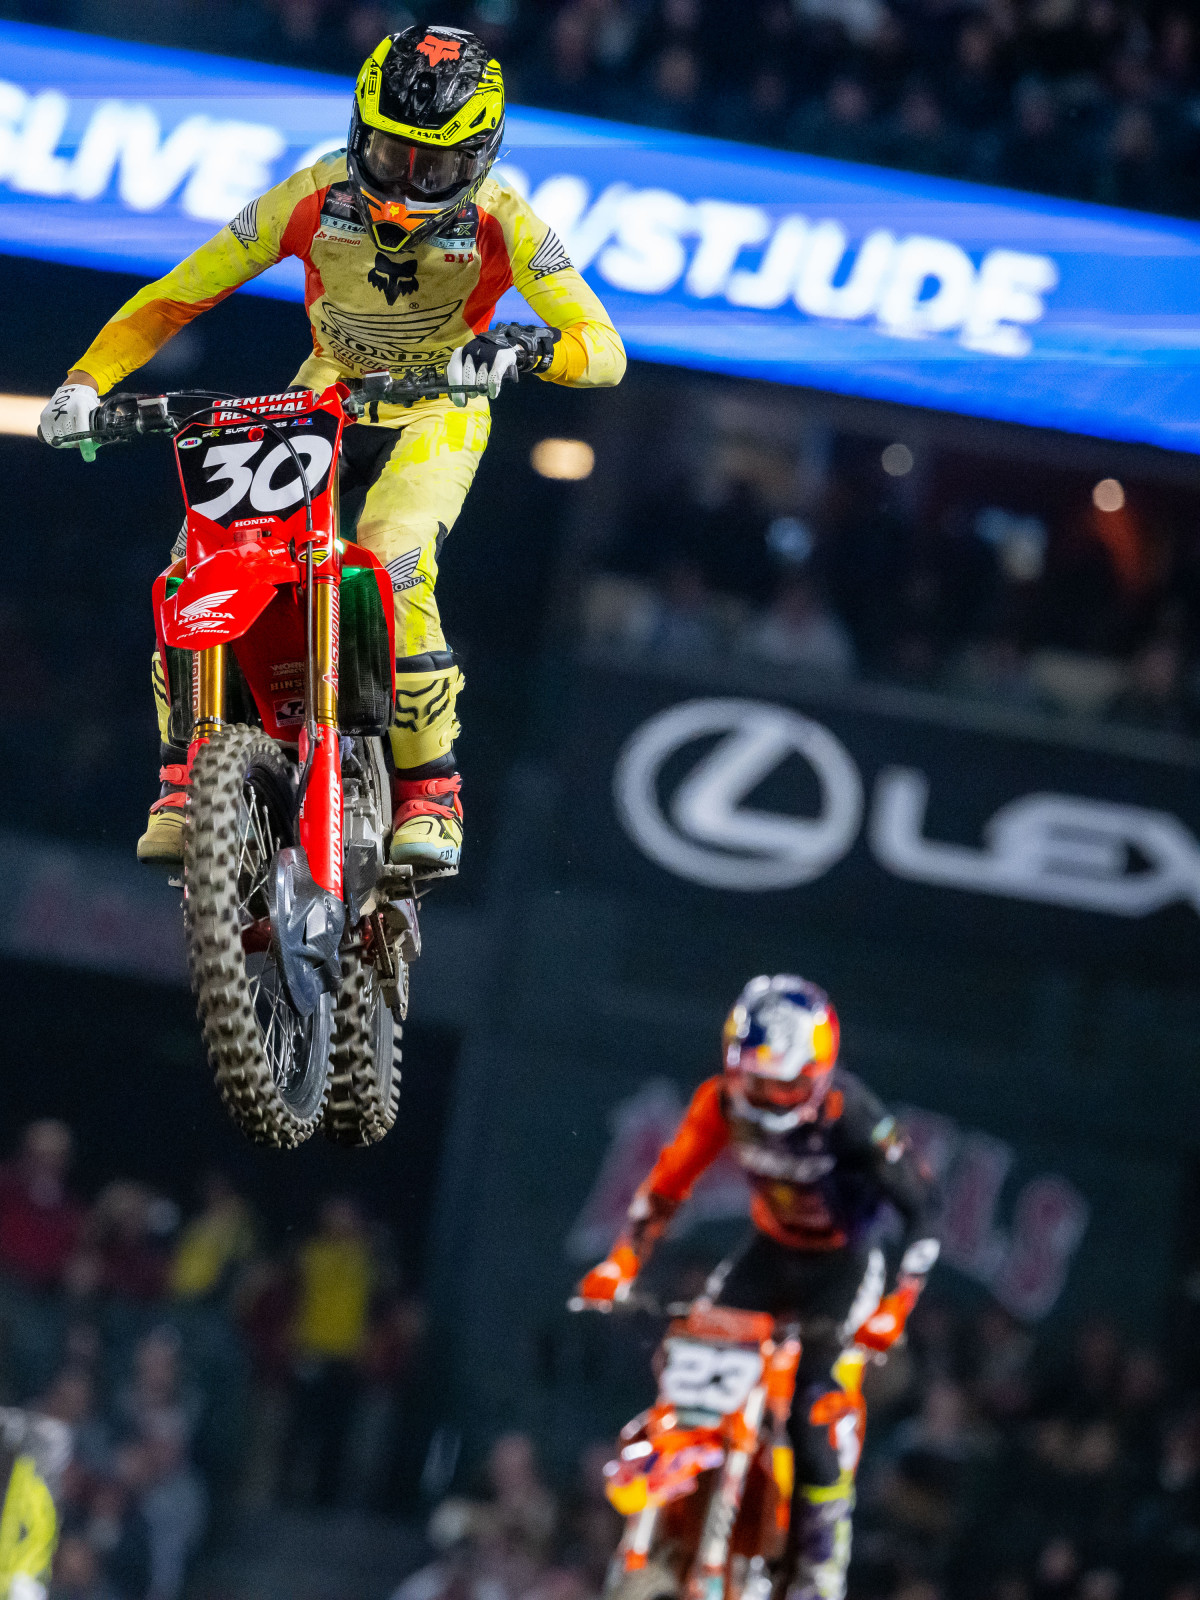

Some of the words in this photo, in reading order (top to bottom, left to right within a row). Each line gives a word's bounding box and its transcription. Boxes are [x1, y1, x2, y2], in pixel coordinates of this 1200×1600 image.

[328, 235, 361, 247] SHOWA
[320, 319, 454, 363] HONDA
[220, 391, 308, 408] RENTHAL
[219, 400, 307, 421] RENTHAL
[190, 434, 333, 521] 30
[234, 517, 277, 528] HONDA
[392, 574, 427, 593] ONDA
[177, 612, 236, 626] HONDA
[331, 771, 341, 887] DUNLOP
